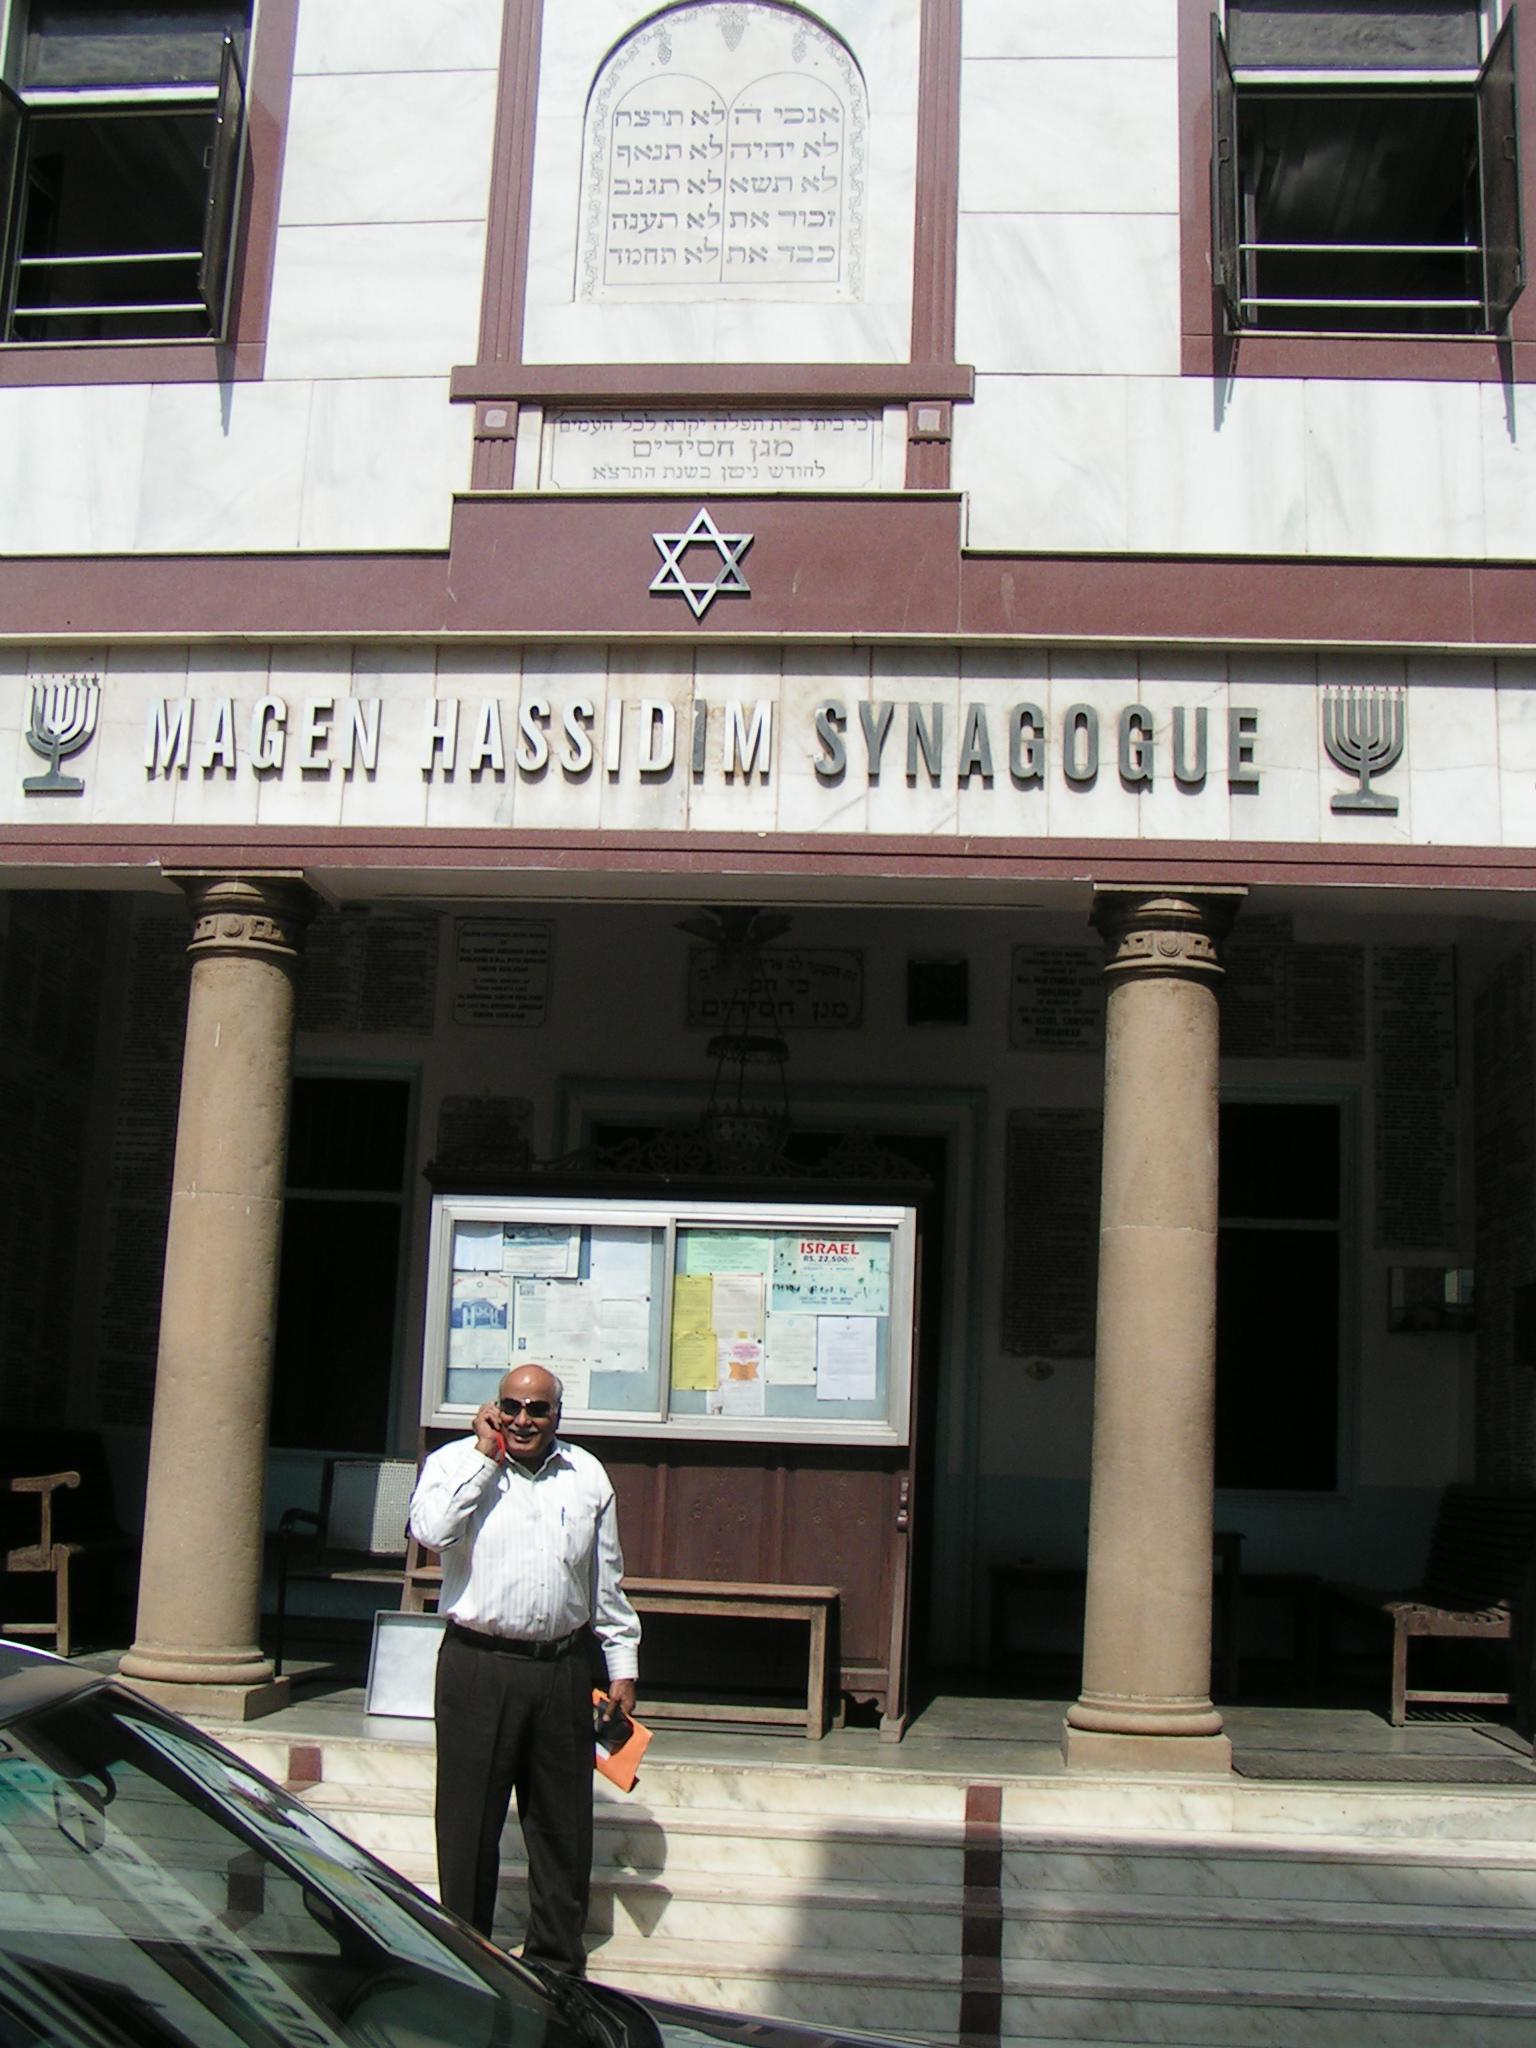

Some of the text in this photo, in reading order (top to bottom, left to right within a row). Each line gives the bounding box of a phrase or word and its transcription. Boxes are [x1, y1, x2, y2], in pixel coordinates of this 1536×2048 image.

[615, 100, 725, 128] לא תרצח
[774, 107, 839, 124] אנכי
[617, 133, 723, 169] לא תנאף
[731, 131, 839, 160] לא יהיה
[613, 168, 722, 196] לא תגנב
[729, 165, 838, 193] לא תשא
[611, 202, 721, 235] לא תענה
[729, 210, 836, 229] זכור את
[608, 236, 719, 265] לא תחמד
[726, 245, 836, 265] כבד את
[559, 411, 869, 437] כי ביתי בית תפלה יקרא לכל העמים
[633, 439, 794, 463] מגן חסידים
[662, 466, 711, 479] בשנת
[768, 459, 825, 479] לחודש
[144, 695, 1260, 786] MAGEN HASSIDIM SYNAGOGUE
[801, 1243, 859, 1255] ISRAEL
